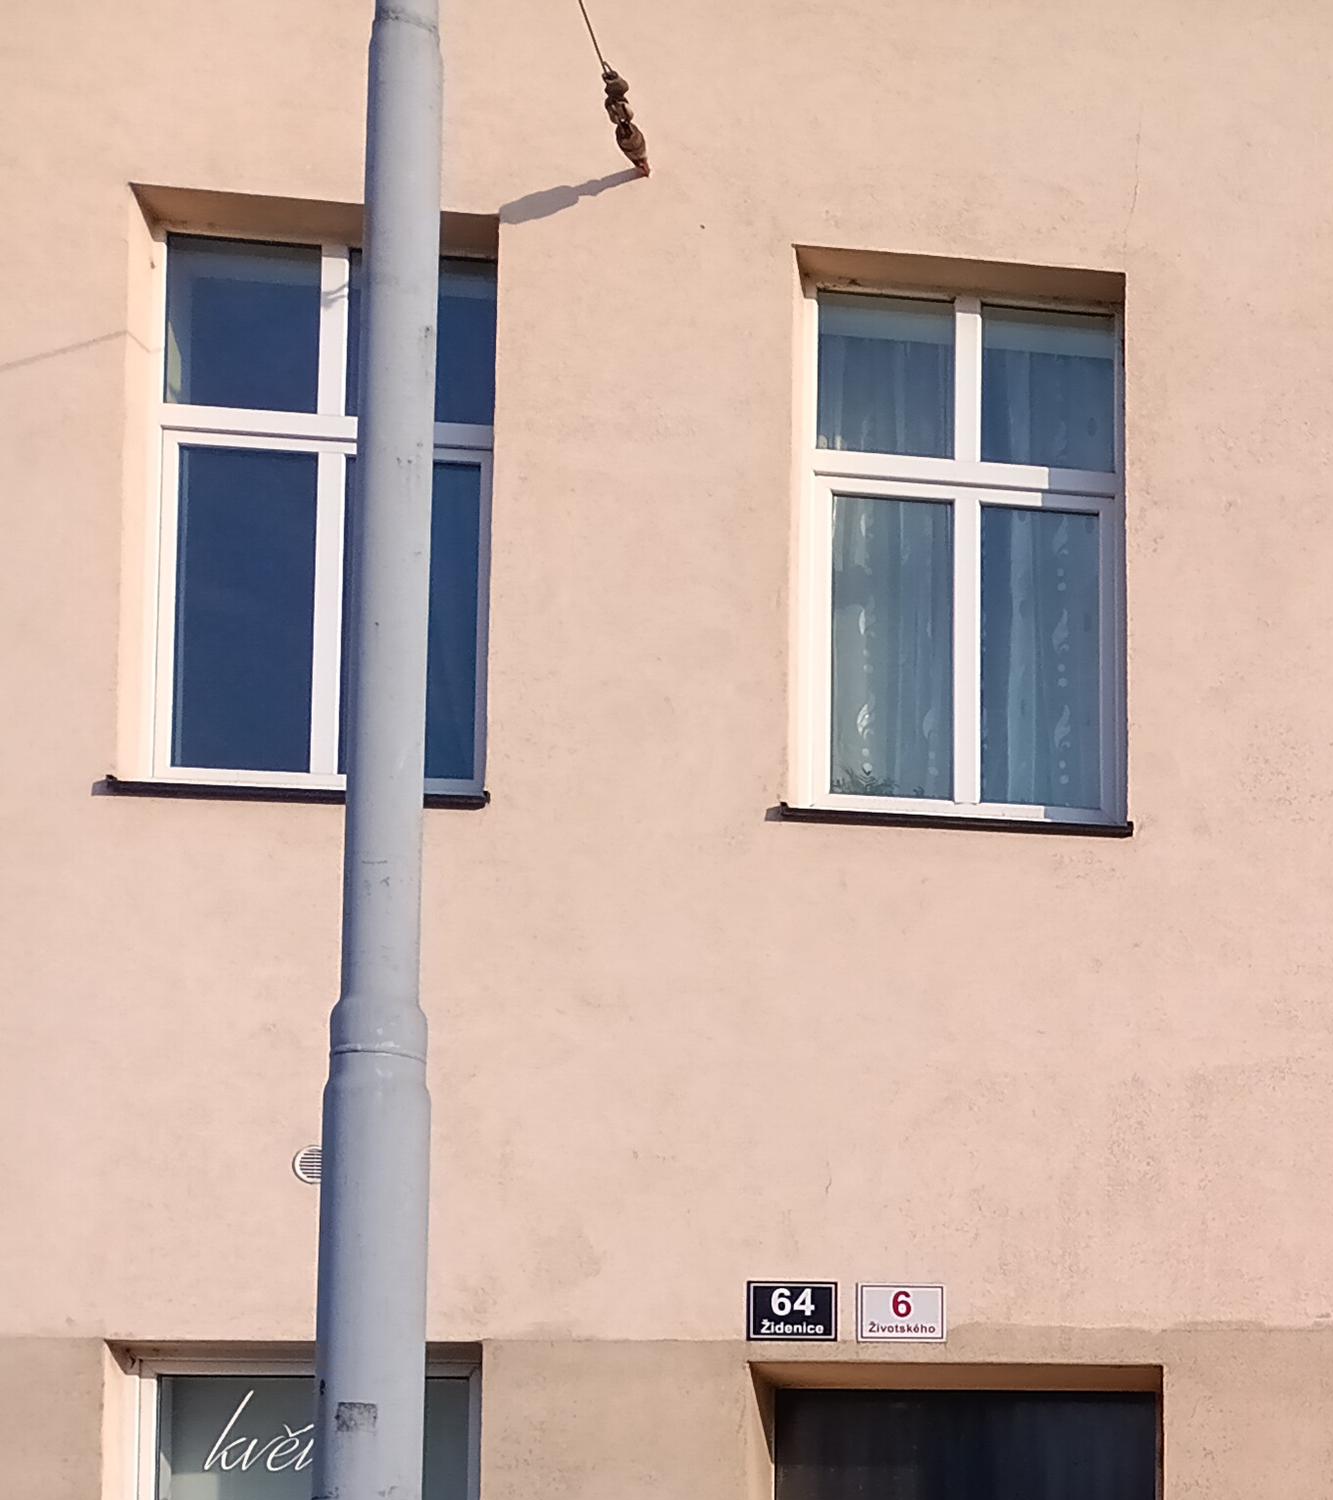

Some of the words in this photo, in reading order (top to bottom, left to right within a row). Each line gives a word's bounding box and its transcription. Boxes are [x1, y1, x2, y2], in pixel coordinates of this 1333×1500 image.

[770, 1287, 816, 1317] 64
[891, 1290, 913, 1318] 6
[760, 1318, 825, 1334] Židenice
[868, 1320, 937, 1334] Životského
